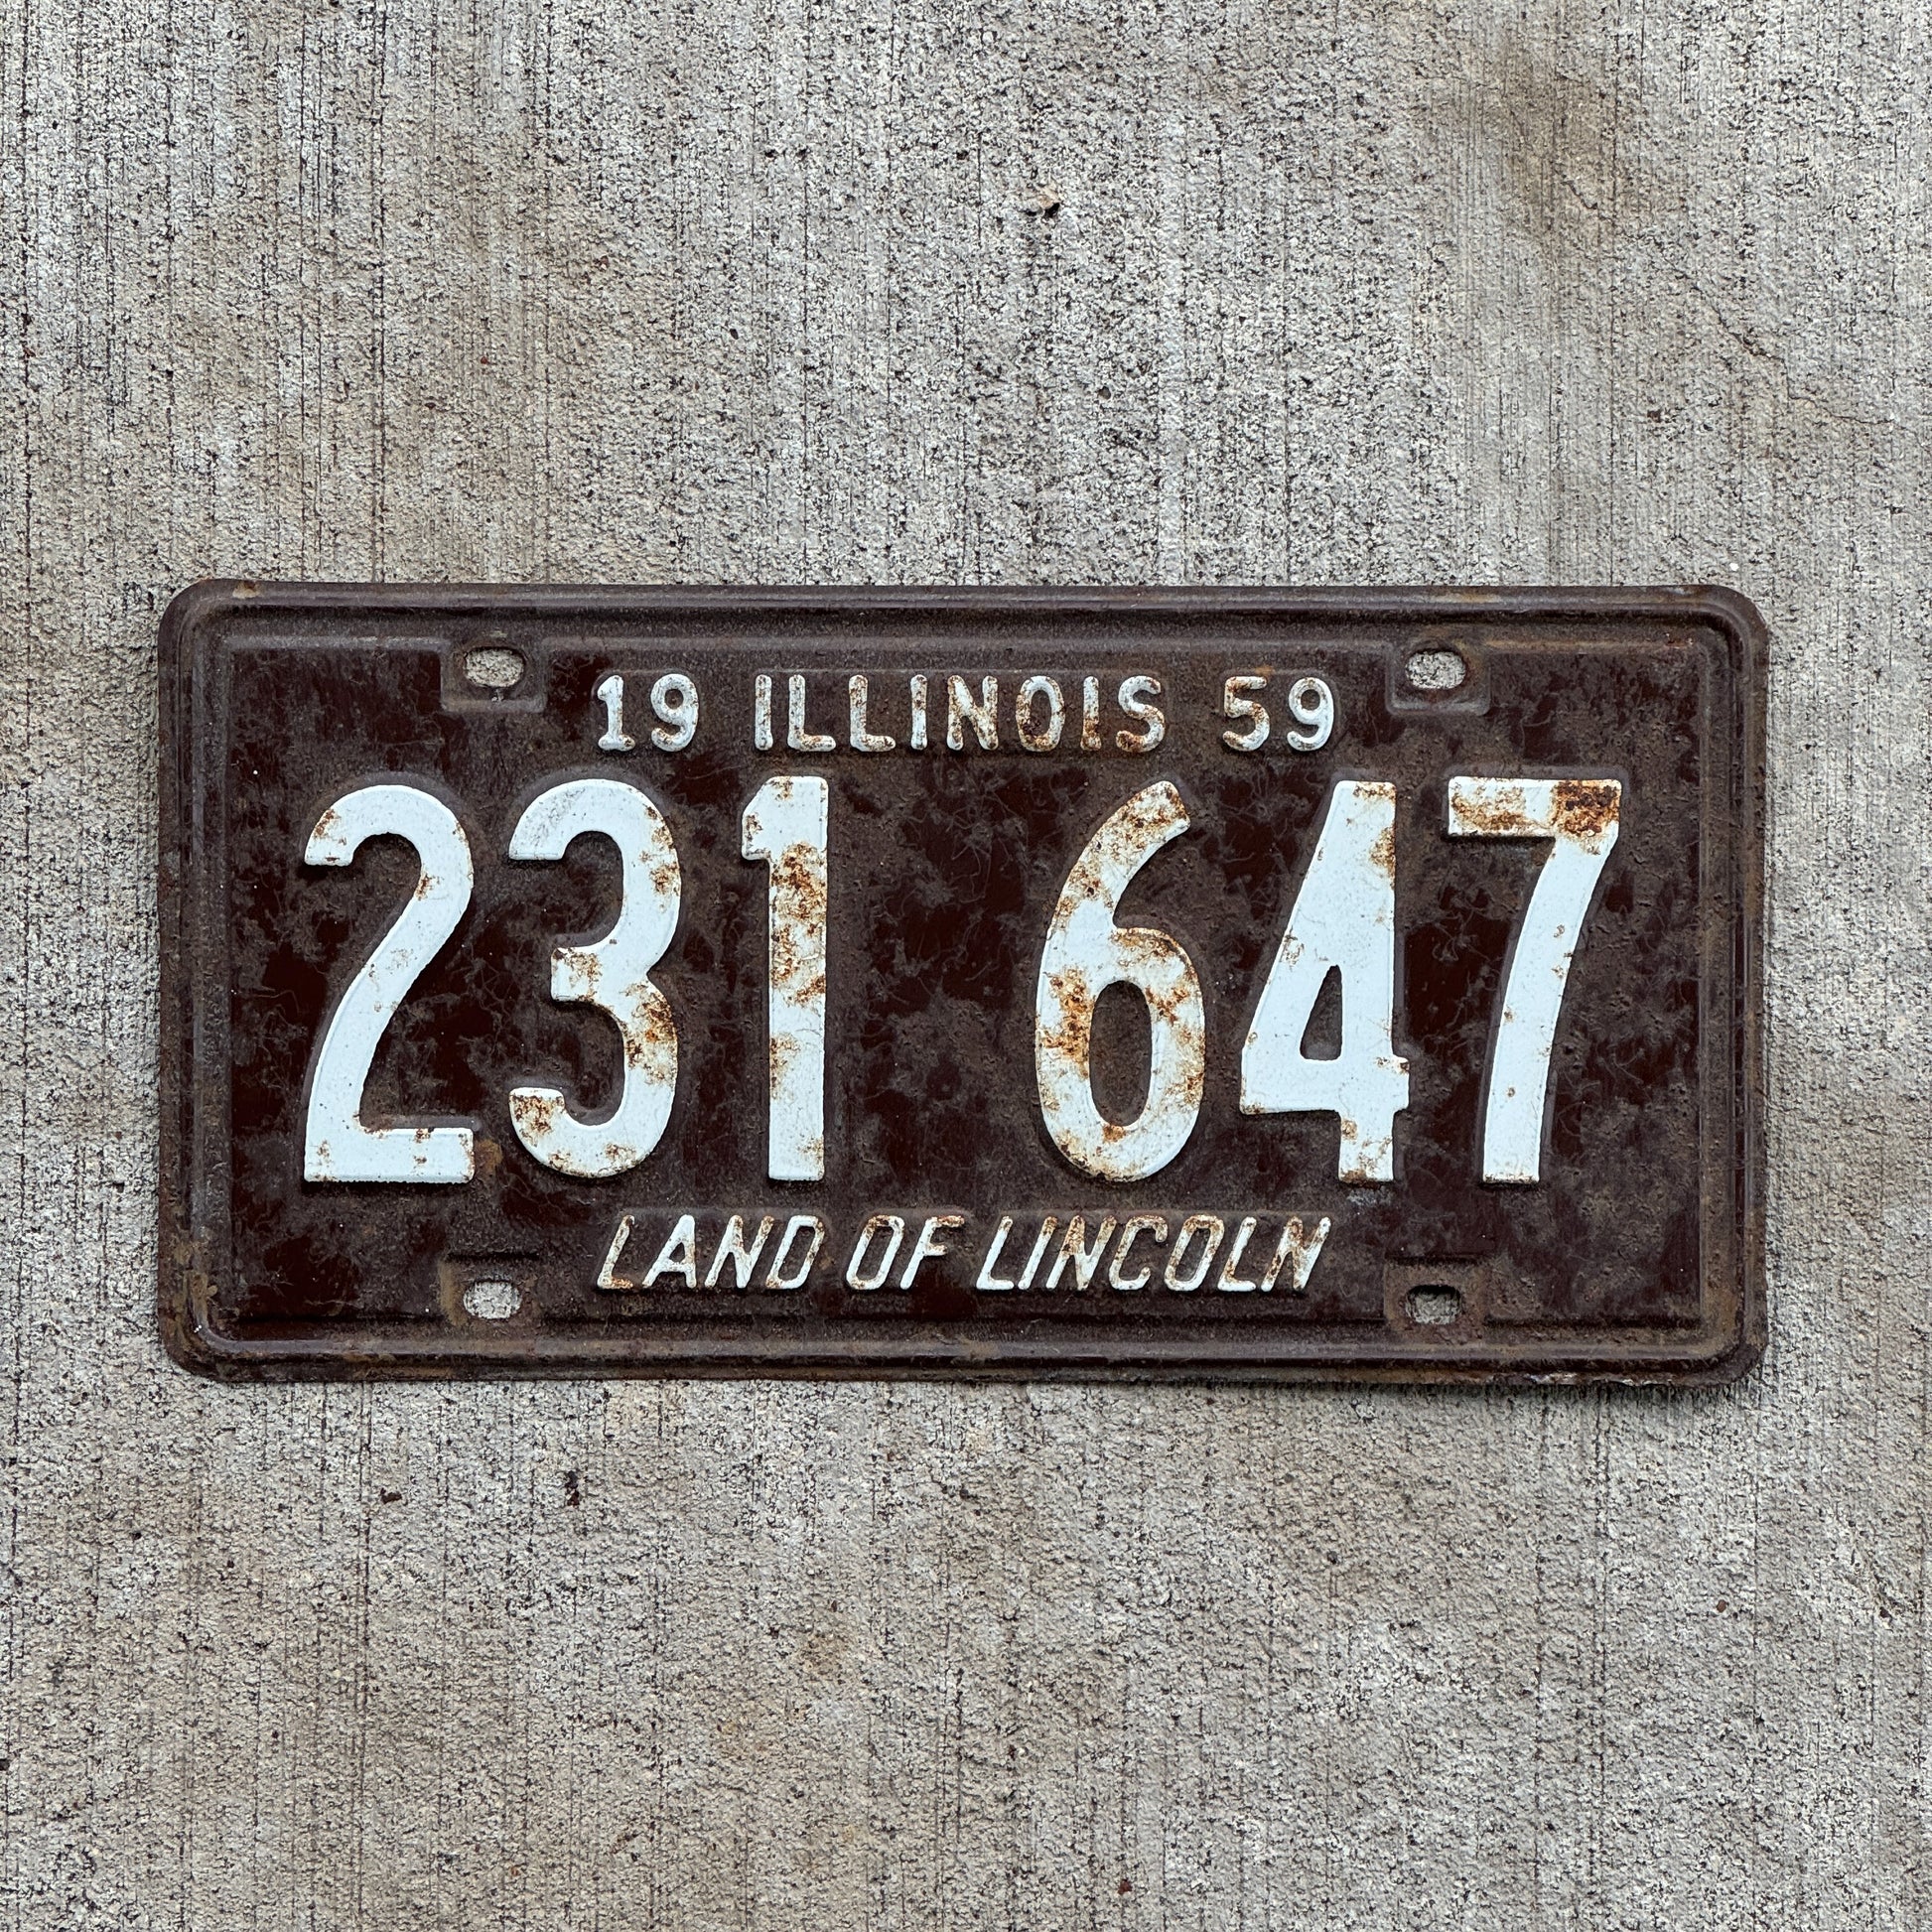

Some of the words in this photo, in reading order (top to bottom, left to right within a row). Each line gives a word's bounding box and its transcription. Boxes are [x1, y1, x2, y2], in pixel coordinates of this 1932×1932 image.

[598, 674, 699, 752] 19
[755, 674, 1166, 753] ILLINOIS
[1222, 674, 1334, 752] 59
[304, 775, 828, 1183] 231
[1035, 775, 1623, 1184] 647
[597, 1214, 825, 1290] LAND
[846, 1214, 965, 1290] OF
[976, 1214, 1331, 1292] LINCOLN
